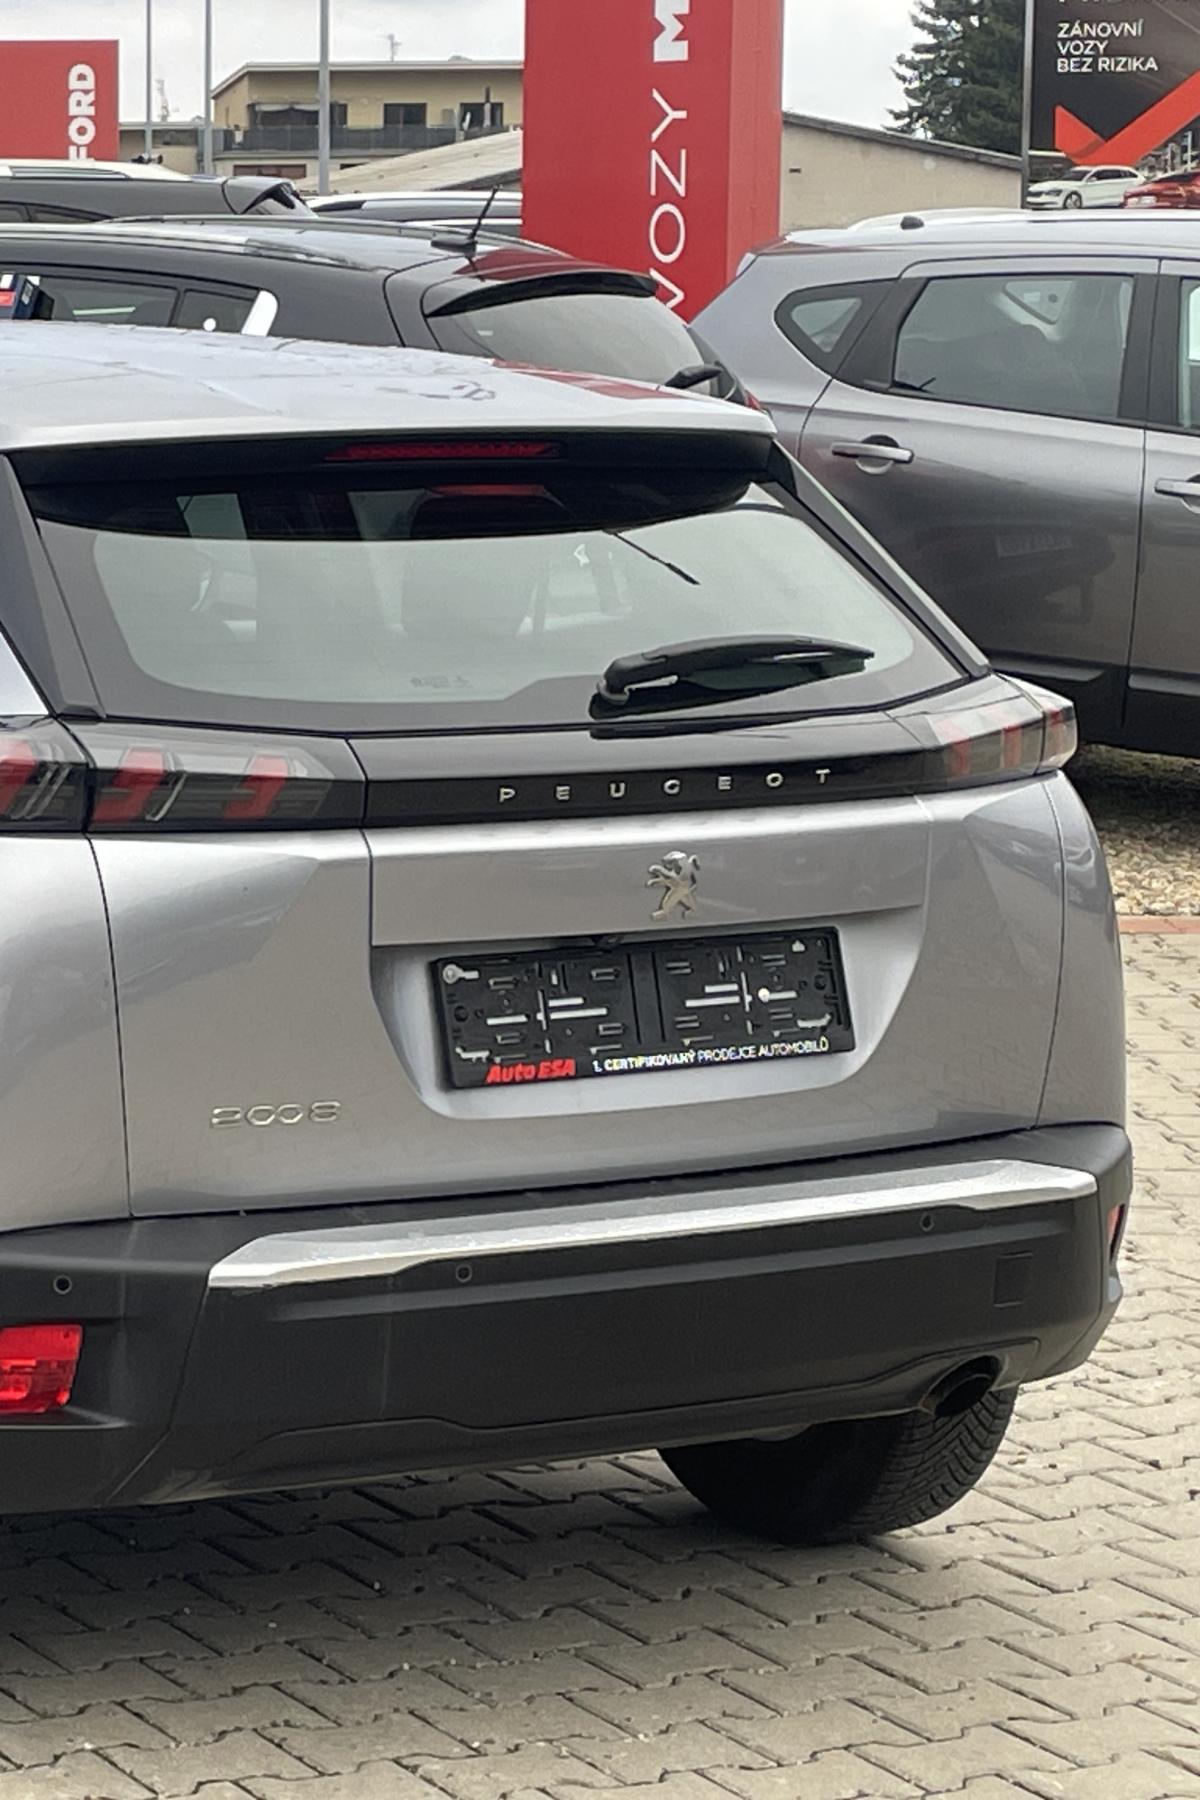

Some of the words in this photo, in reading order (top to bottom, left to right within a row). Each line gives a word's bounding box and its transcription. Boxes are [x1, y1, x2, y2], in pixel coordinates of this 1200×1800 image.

[1056, 18, 1144, 38] ZÁNOVNÍ
[1056, 40, 1109, 55] VOZY
[1056, 57, 1093, 73] BEZ
[1097, 57, 1158, 73] RIZIKA
[67, 63, 96, 164] FORD
[650, 88, 688, 310] VOZY
[499, 767, 831, 802] PEUGEOT
[697, 1045, 756, 1063] PRODEJCE
[209, 1100, 341, 1129] 2008
